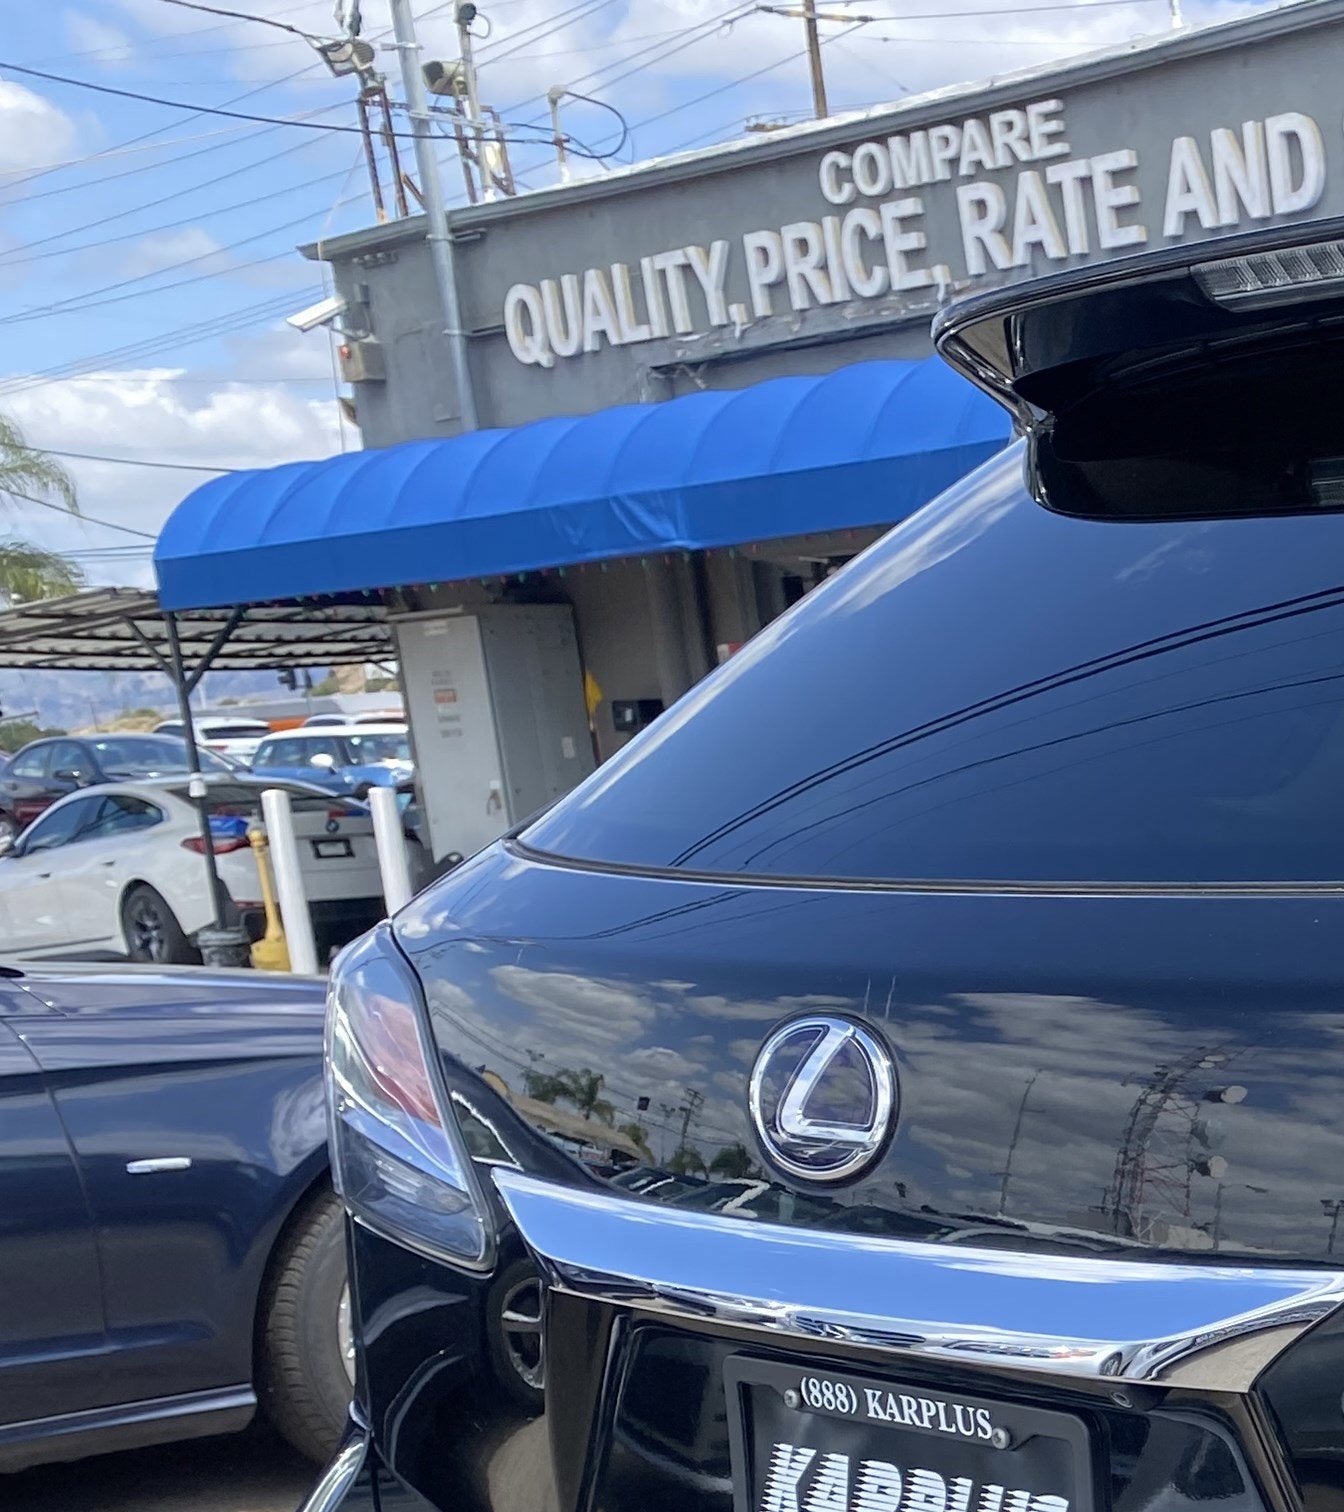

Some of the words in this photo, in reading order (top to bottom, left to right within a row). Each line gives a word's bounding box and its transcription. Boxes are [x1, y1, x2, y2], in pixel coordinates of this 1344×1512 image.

[819, 99, 1071, 204] COMPARE
[504, 239, 748, 367] QUALITY,
[743, 198, 951, 316] PRICE,
[957, 149, 1147, 276] RATE
[1163, 112, 1325, 237] AND
[800, 1377, 858, 1415] (888)
[864, 1388, 992, 1439] KARPLUS
